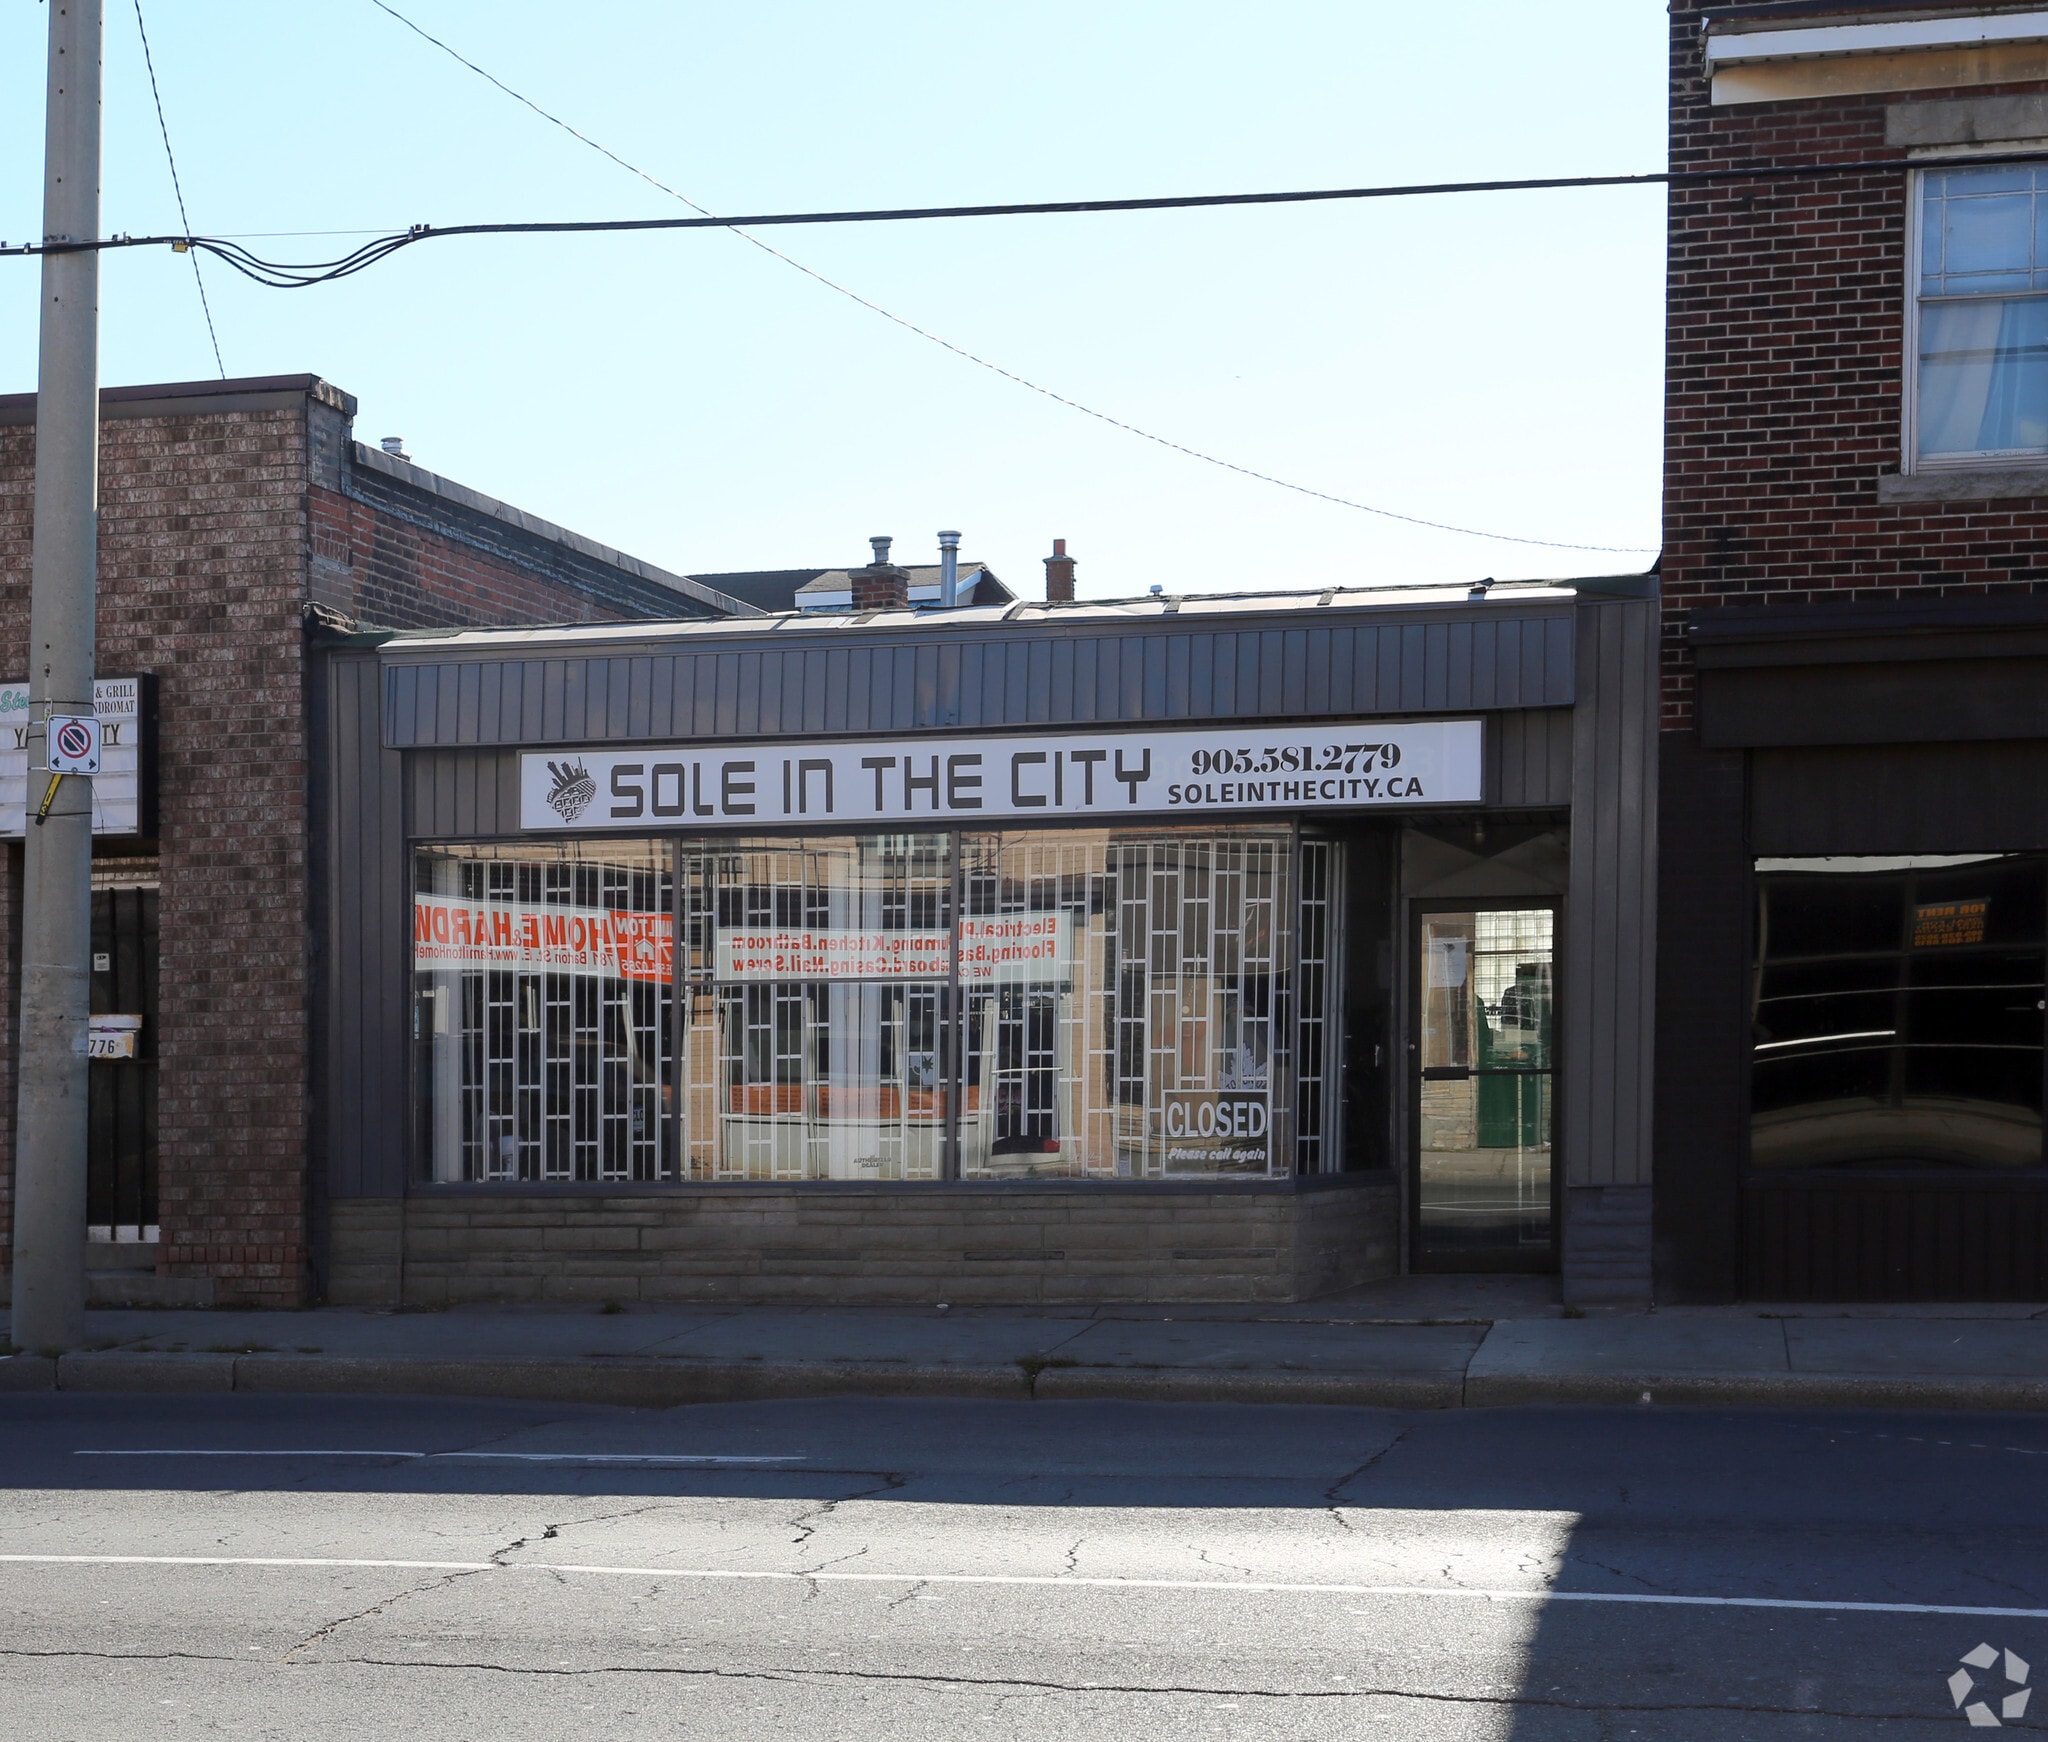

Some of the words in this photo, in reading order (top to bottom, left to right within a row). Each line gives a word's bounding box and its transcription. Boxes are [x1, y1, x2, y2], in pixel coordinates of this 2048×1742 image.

[95, 686, 102, 698] &
[106, 684, 135, 698] GRILL
[1190, 743, 1402, 775] 905.581.2779
[610, 760, 756, 818] SOLE
[783, 758, 833, 815] IN
[861, 753, 982, 812] THE
[1011, 748, 1150, 807] CITY
[1167, 776, 1425, 805] SOLEINTHECITY.CA
[90, 1039, 115, 1053] 776
[1167, 1102, 1266, 1137] CLOSED
[1168, 1147, 1207, 1160] Please
[1209, 1147, 1232, 1160] call
[1232, 1148, 1266, 1163] again
